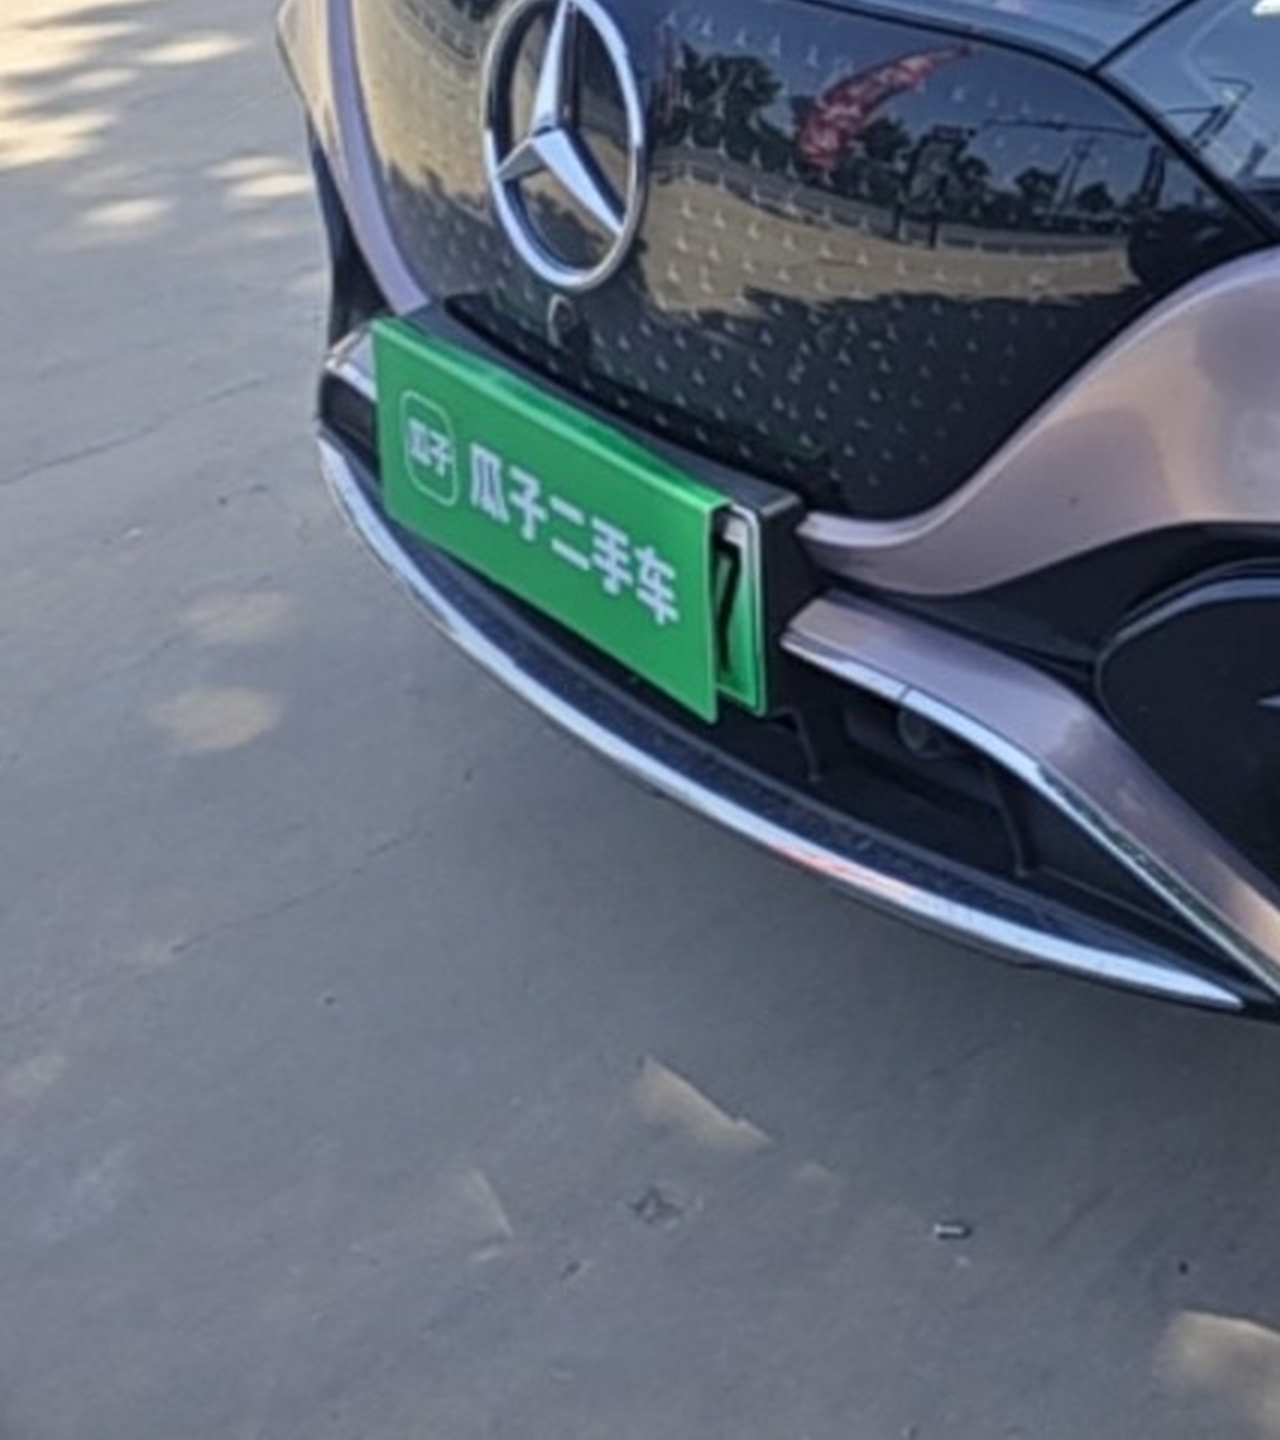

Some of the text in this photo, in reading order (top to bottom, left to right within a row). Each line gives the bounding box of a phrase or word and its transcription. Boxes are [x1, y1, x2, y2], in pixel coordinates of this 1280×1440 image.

[469, 441, 680, 626] 瓜子二手车
